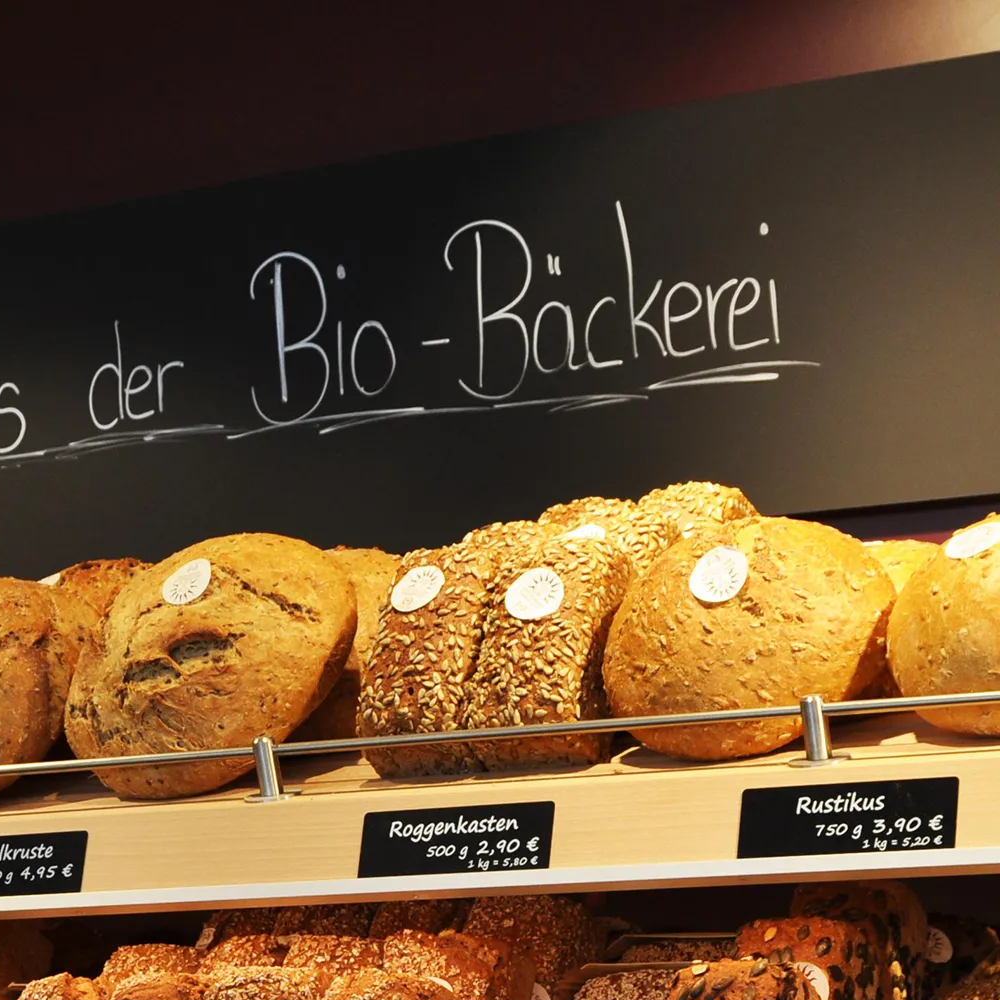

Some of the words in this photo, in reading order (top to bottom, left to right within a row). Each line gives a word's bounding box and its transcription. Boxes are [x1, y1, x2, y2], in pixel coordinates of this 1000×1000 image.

[88, 320, 184, 430] der
[796, 792, 885, 815] Rustikus
[389, 815, 518, 842] Roggenkasten
[815, 823, 848, 837] 750
[852, 824, 863, 839] g
[872, 816, 921, 835] 3,90
[928, 815, 943, 830] €
[426, 845, 455, 857] 500
[459, 846, 469, 859] g
[476, 839, 520, 856] 2,90
[526, 837, 539, 852] €
[862, 840, 870, 848] 1
[874, 837, 887, 851] kg
[902, 836, 931, 847] 5,20
[5, 872, 13, 884] g
[20, 865, 57, 881] 4,95
[62, 863, 73, 877] €
[478, 858, 490, 870] kg
[502, 857, 527, 867] 5,80
